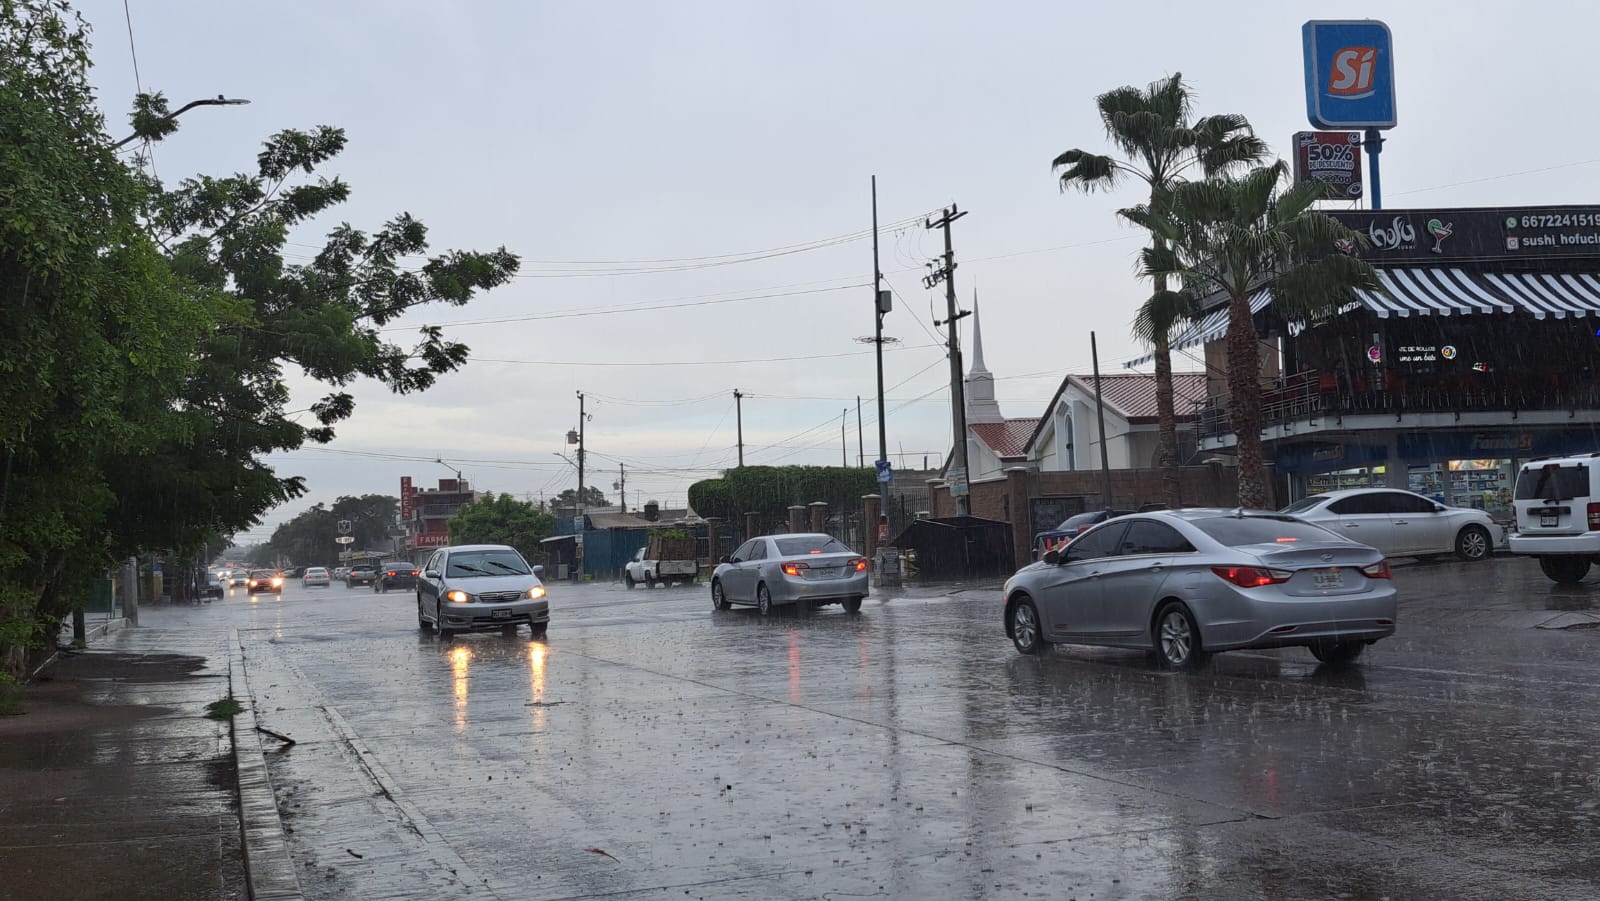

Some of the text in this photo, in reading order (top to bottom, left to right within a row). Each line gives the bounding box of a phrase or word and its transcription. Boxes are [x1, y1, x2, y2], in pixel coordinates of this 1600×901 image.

[1308, 144, 1354, 161] 50%
[1318, 160, 1354, 170] DESCUENTO
[1521, 214, 1600, 228] 6672241519
